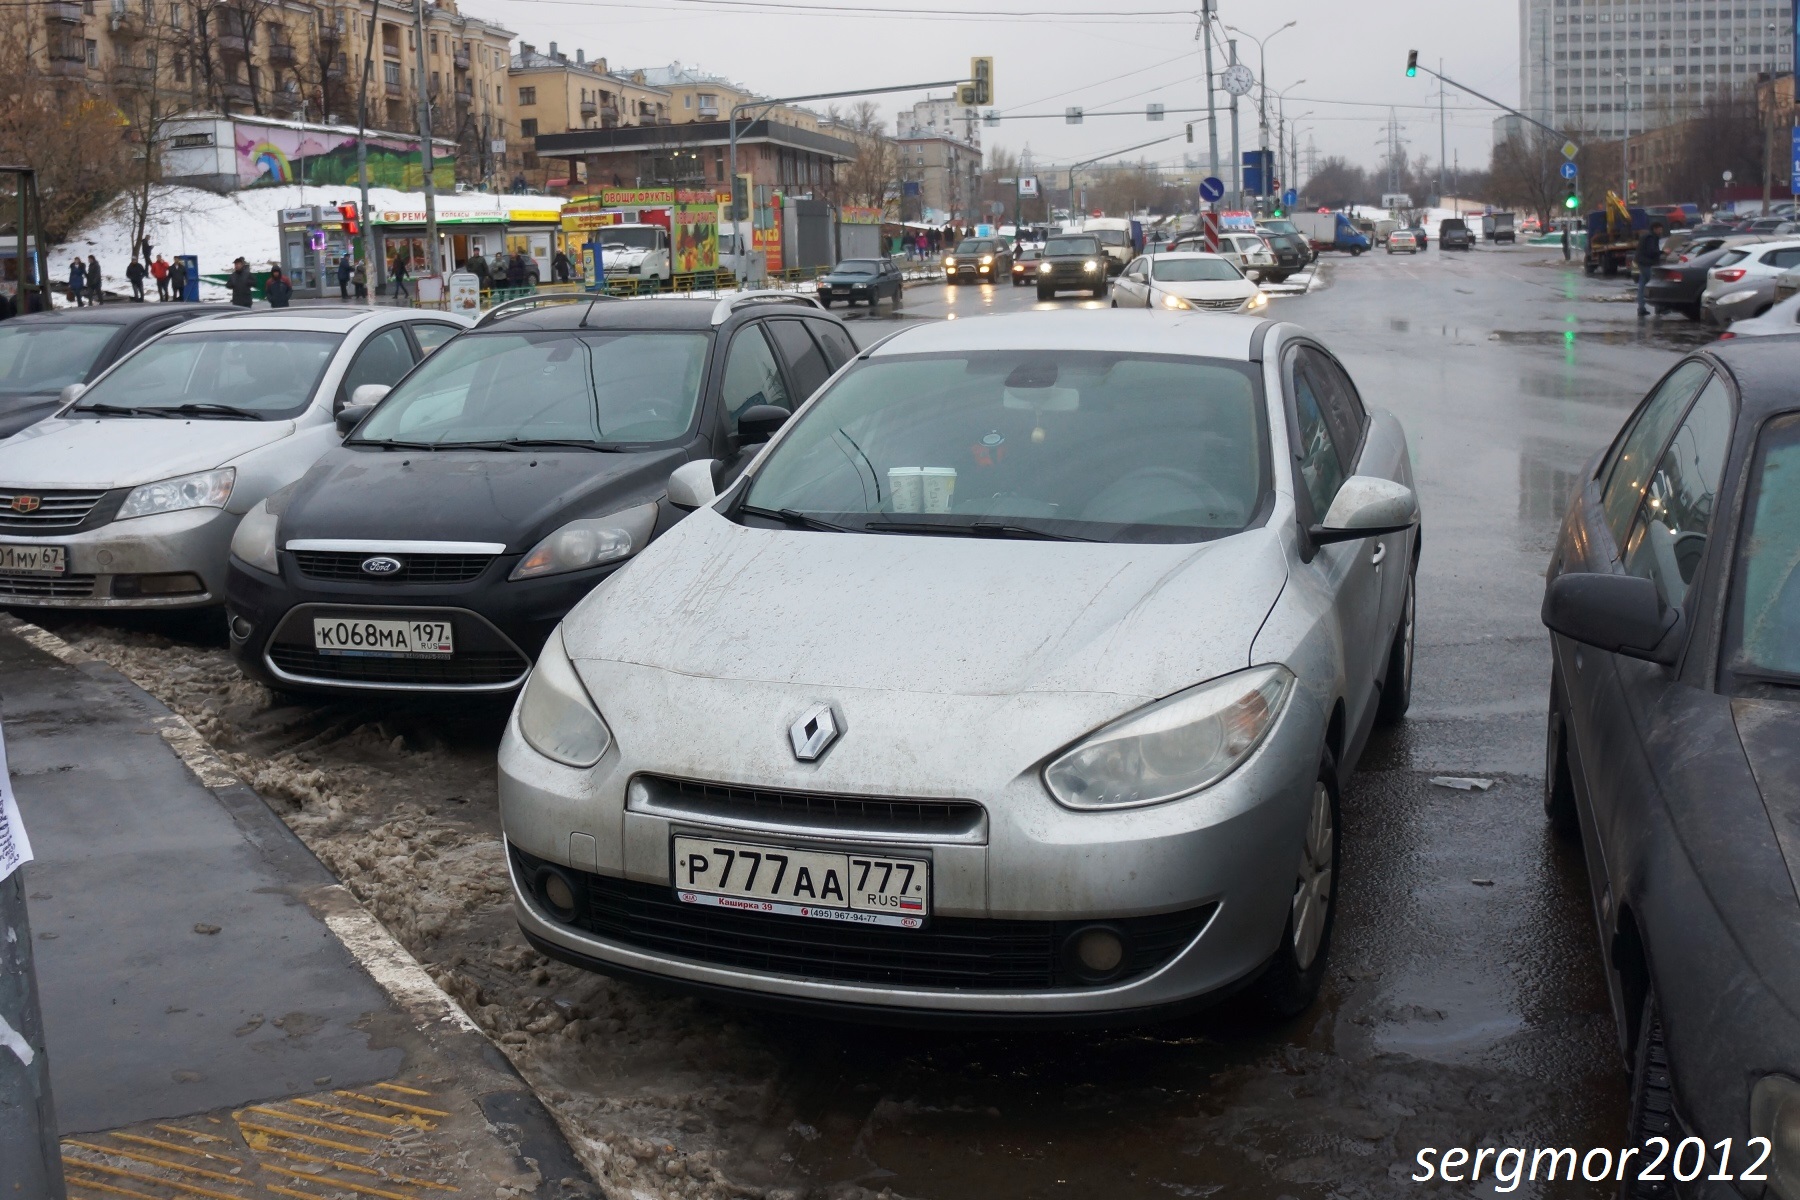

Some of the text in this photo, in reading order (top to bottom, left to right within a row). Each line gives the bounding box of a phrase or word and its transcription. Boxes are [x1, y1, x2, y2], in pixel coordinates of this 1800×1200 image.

[604, 192, 635, 203] ОВОЩИ
[638, 191, 673, 203] ФРУКТЫ
[402, 211, 428, 222] РЕМИ
[42, 548, 59, 563] 67
[369, 560, 391, 572] Ford
[320, 622, 445, 648] К068МА 197
[421, 642, 438, 650] RUS
[688, 847, 915, 901] Р777АА 777
[718, 898, 773, 911] Каширка 39
[867, 893, 898, 907] RUS
[810, 908, 878, 923] (495) 967-94-77
